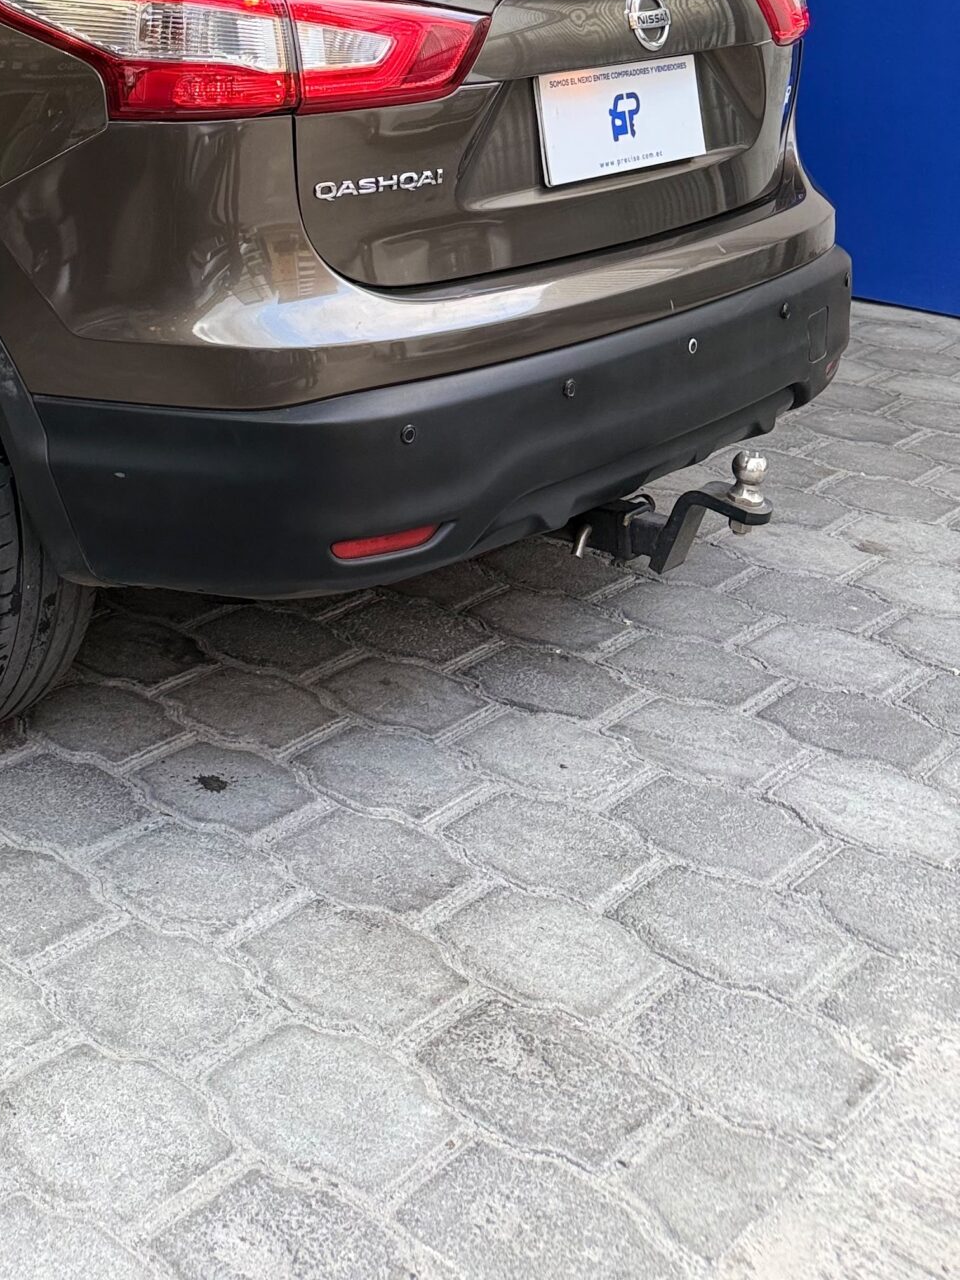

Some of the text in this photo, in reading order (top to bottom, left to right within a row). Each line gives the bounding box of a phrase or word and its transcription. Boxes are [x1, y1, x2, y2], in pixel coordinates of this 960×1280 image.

[549, 78, 569, 88] SOMOS
[570, 77, 577, 85] EL
[577, 75, 593, 84] NEXO
[593, 72, 610, 82] ENTRE
[611, 67, 651, 80] COMPRADORES
[654, 62, 687, 73] VENDEDORES
[315, 168, 443, 201] QASHQAI
